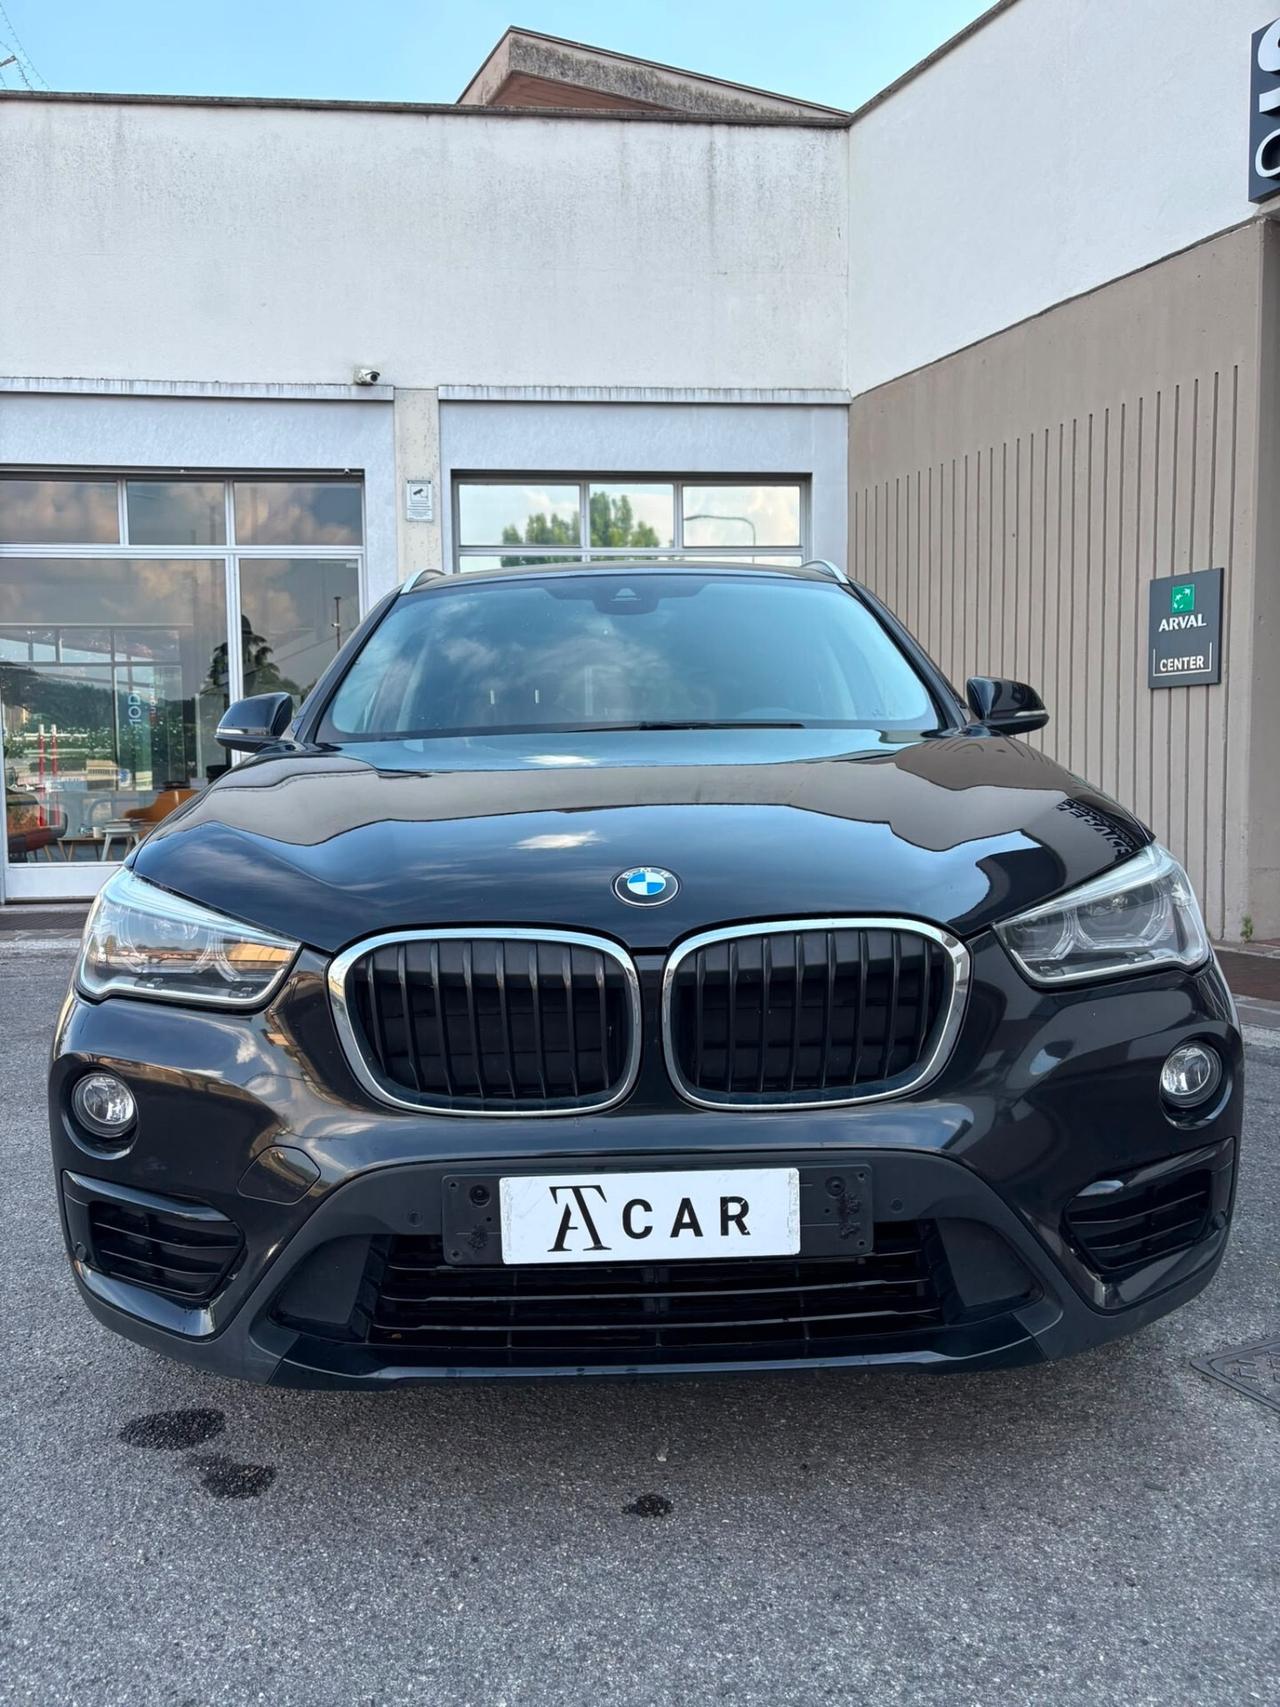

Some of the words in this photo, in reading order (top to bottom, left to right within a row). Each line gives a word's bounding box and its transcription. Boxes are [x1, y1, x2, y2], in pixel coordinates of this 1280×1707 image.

[1159, 613, 1207, 632] ARVAL
[1160, 655, 1204, 672] CENTER
[622, 1196, 752, 1239] CAR
